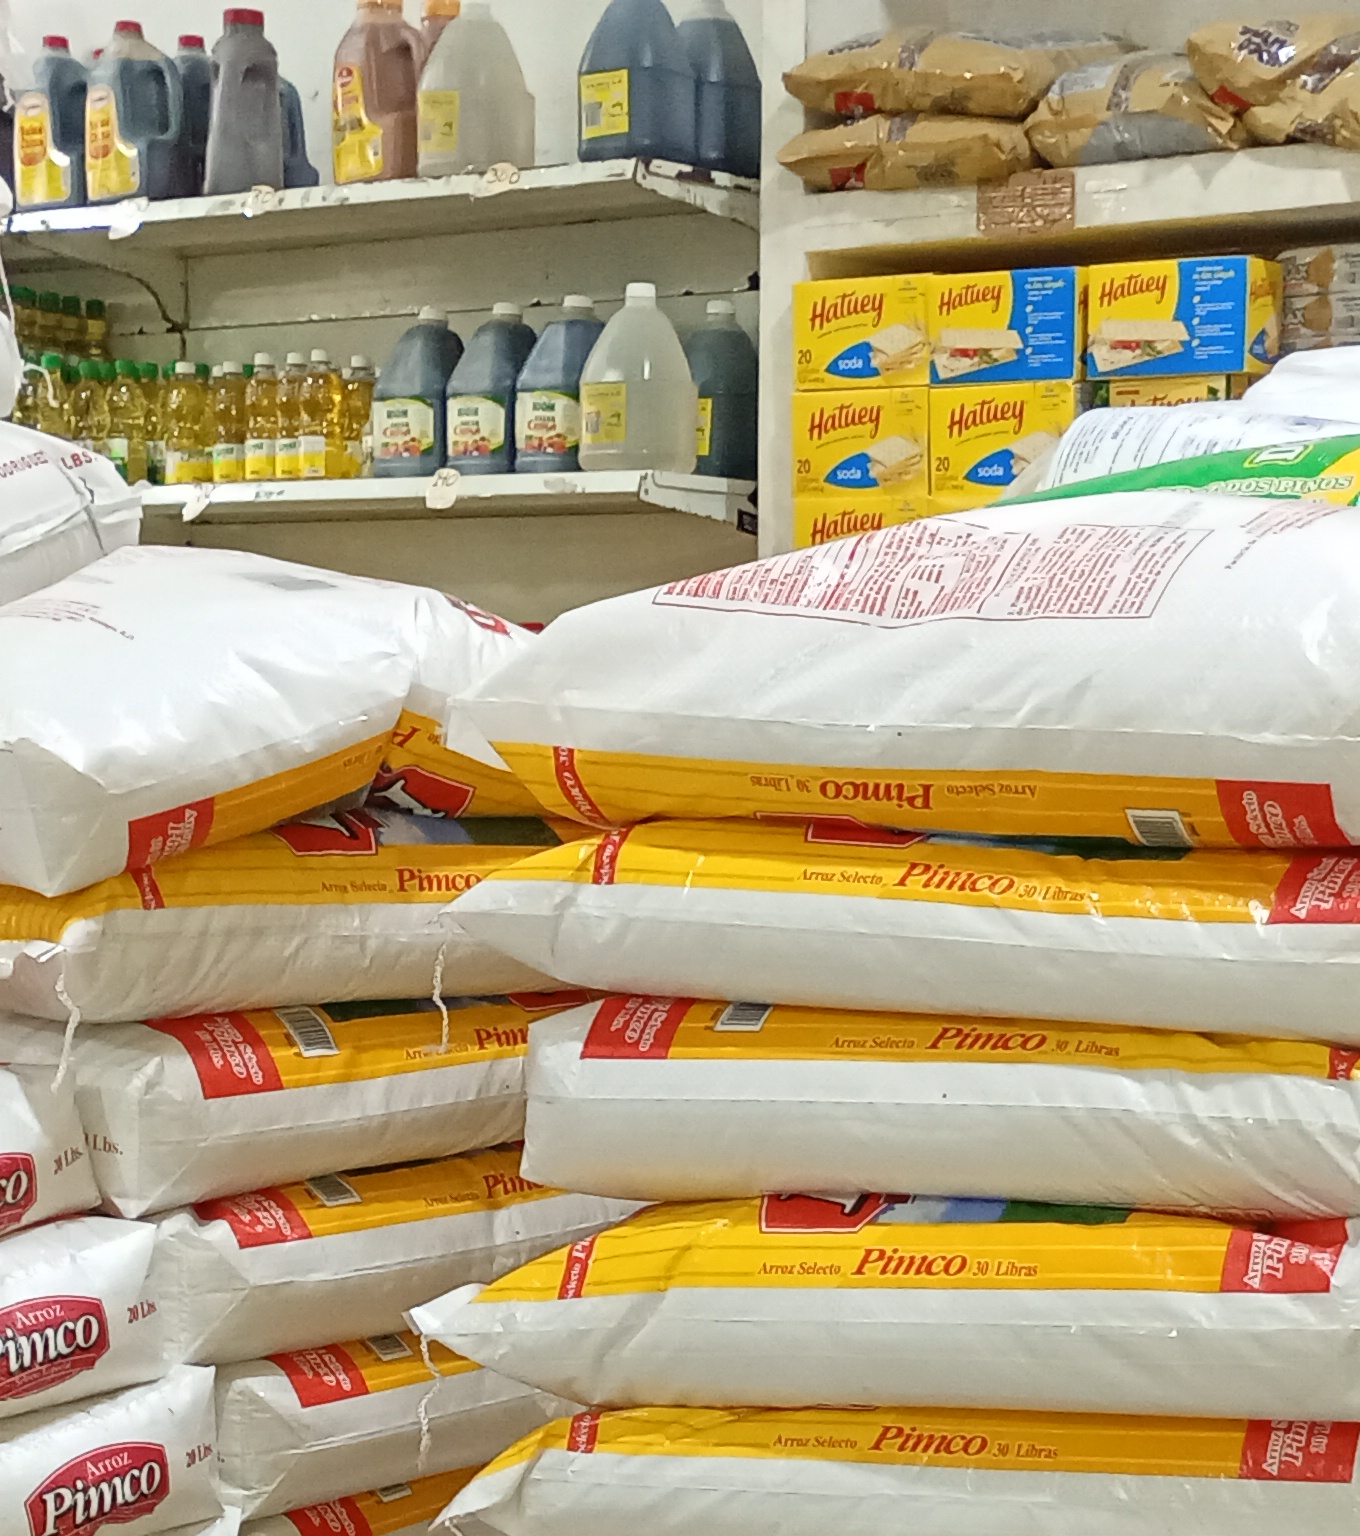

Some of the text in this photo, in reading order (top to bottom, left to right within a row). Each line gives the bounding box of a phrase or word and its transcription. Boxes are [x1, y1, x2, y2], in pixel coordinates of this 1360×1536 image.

[938, 283, 1004, 317] Hatuey
[1098, 273, 1168, 308] Hatuey
[809, 290, 884, 331] Hatuey
[797, 349, 812, 365] 20
[838, 355, 862, 372] soda
[808, 403, 881, 441] Hatuey
[948, 398, 1026, 437] Hatuey
[797, 458, 811, 475] 20
[836, 465, 861, 483] soda
[935, 457, 949, 474] 20
[977, 463, 1004, 480] soda
[1226, 475, 1353, 494] DOS PINOS
[750, 774, 1038, 811] Arroz Selecto Pimco 30 Libras
[395, 866, 481, 892] Pimco
[798, 862, 1087, 902] Arroz Selecto Pimco 30 Libras
[831, 1026, 1120, 1057] Arroz Selecto Pimco 30 Libras
[758, 1248, 1038, 1278] Arroz Selecto Pimco 30 Libras
[14, 1303, 64, 1330] Arroz
[774, 1425, 1059, 1460] Arroz Selecto Pimco 30 Libras
[85, 1452, 131, 1480] Arroz
